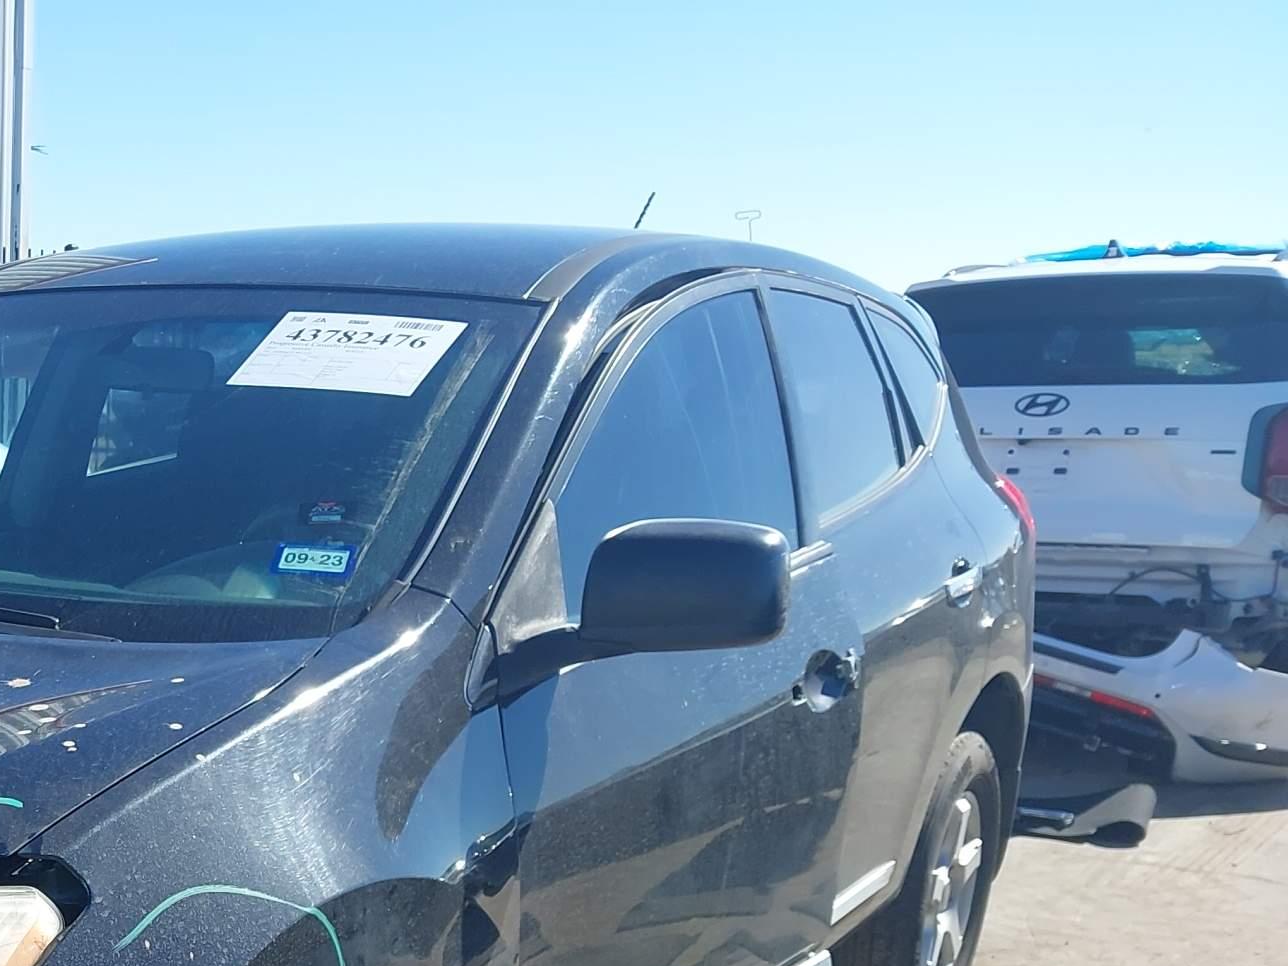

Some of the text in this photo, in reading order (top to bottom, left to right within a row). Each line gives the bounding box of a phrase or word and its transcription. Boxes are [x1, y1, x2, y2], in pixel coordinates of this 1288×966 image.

[285, 328, 431, 349] 43782476
[979, 427, 1181, 436] LISADE
[284, 552, 344, 567] 09 23
